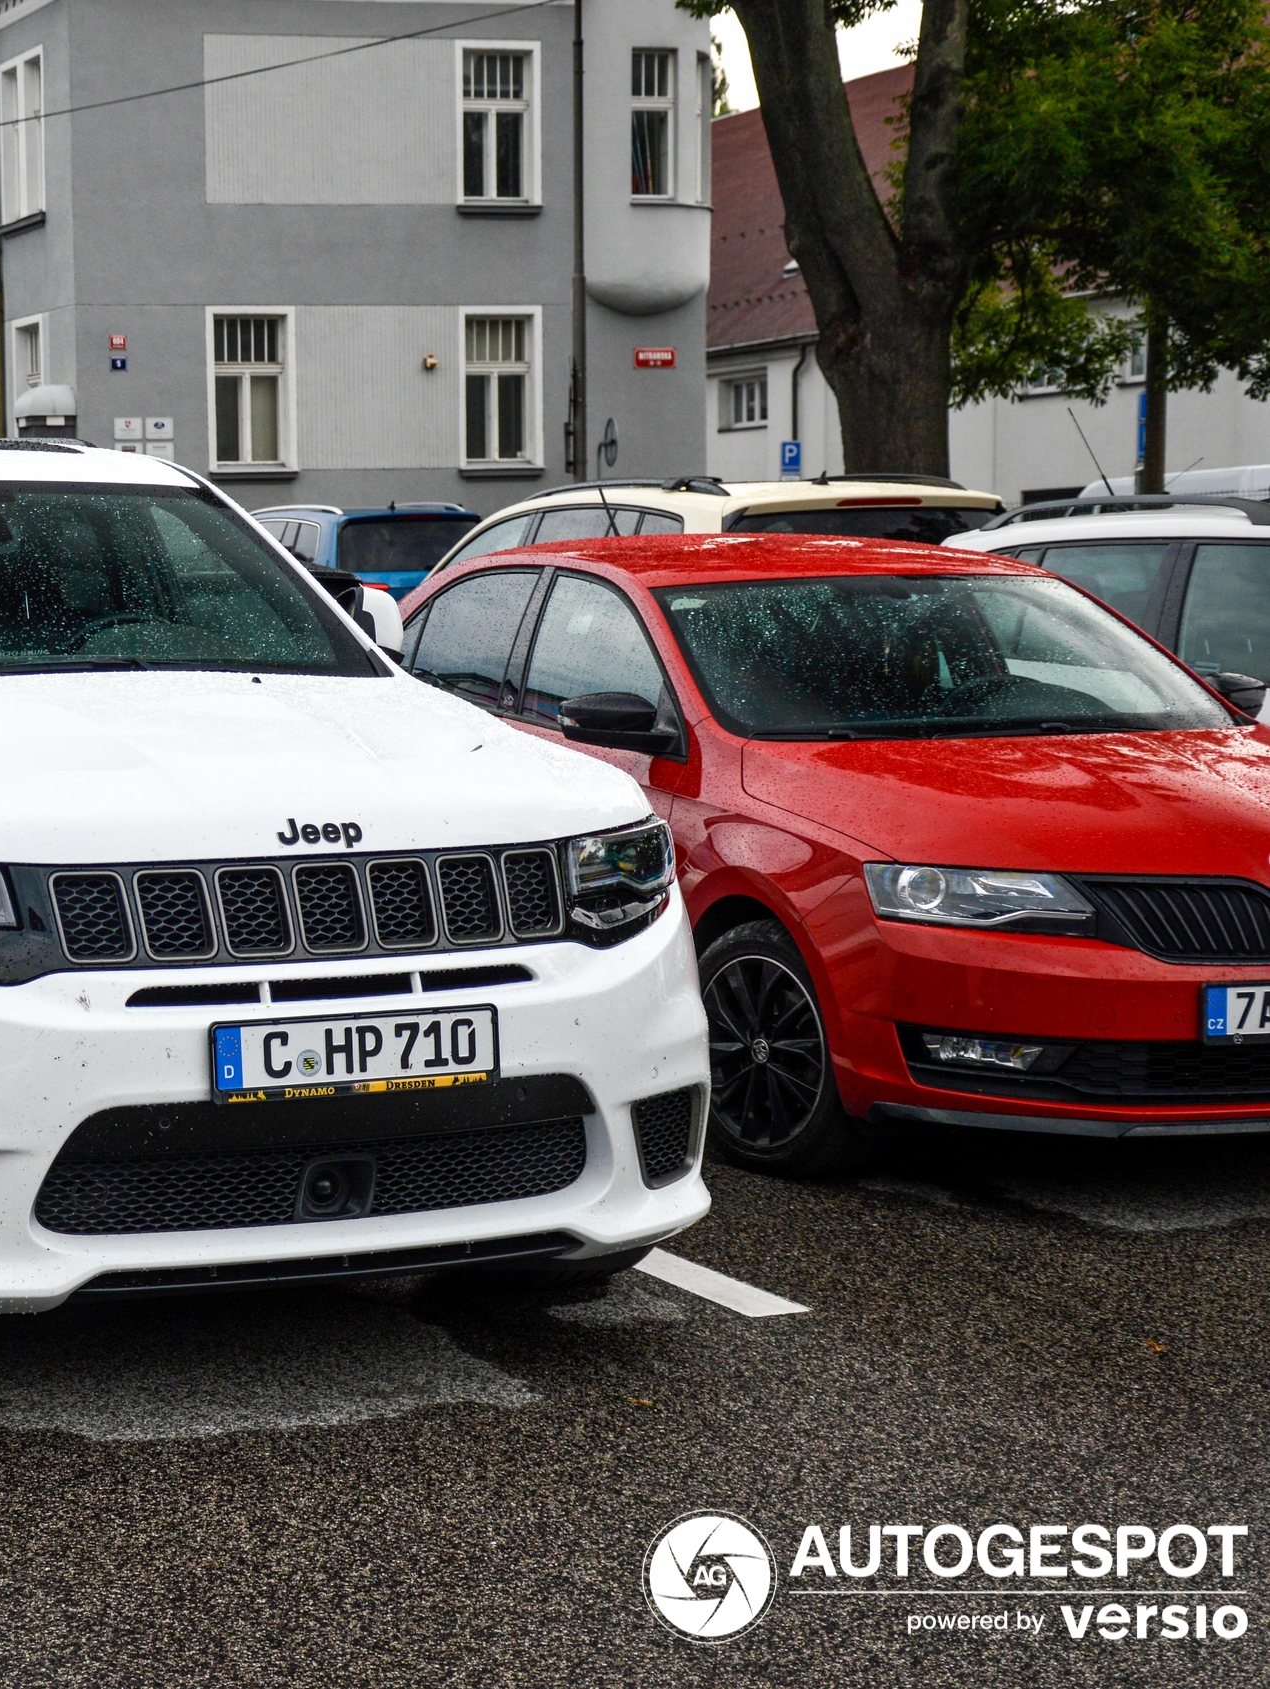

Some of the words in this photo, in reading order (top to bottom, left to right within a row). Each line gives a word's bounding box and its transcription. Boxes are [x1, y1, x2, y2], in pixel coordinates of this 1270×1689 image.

[785, 445, 798, 464] P
[276, 818, 363, 848] Jeep
[1208, 1018, 1224, 1030] CZ
[263, 1030, 293, 1079] C
[324, 1024, 383, 1075] HP
[394, 1018, 477, 1070] 710
[224, 1065, 234, 1079] D
[285, 1086, 335, 1098] DYNAMO
[386, 1079, 436, 1091] DRESDEN
